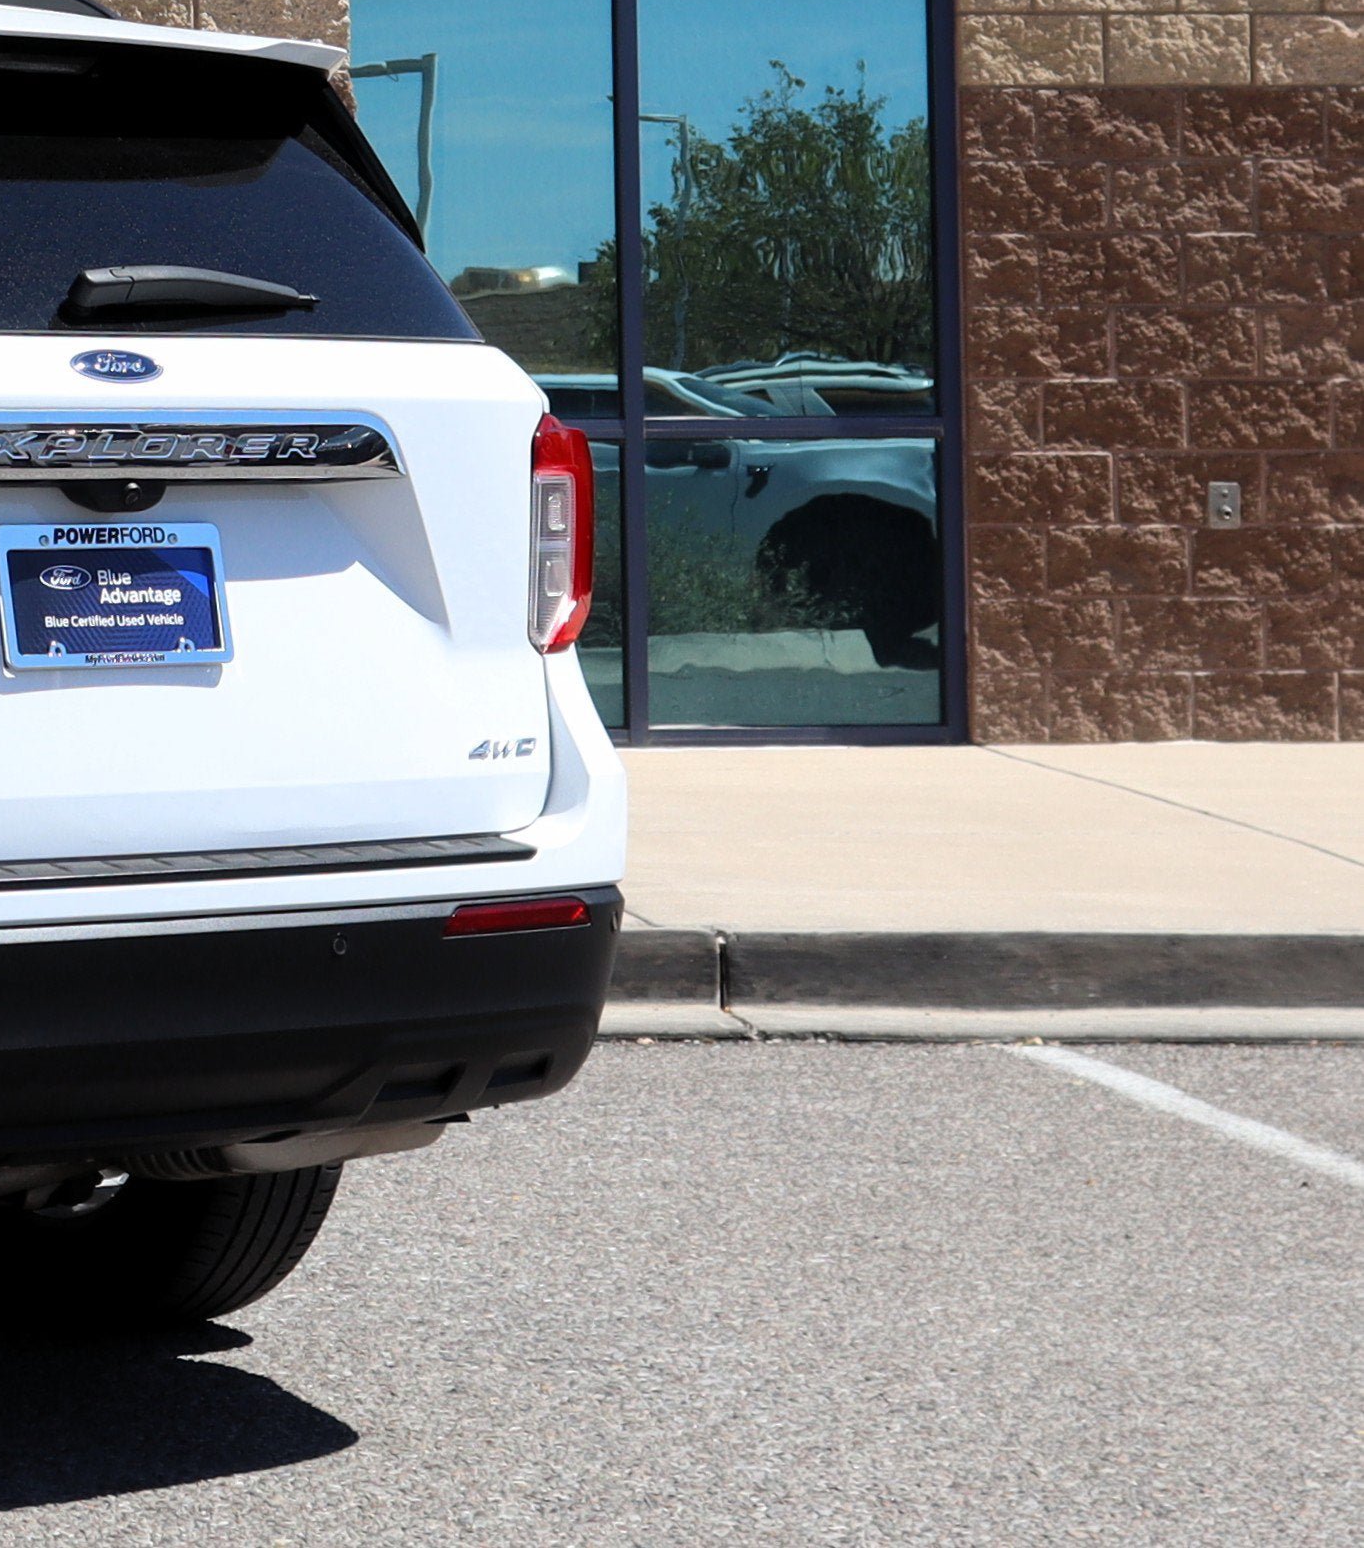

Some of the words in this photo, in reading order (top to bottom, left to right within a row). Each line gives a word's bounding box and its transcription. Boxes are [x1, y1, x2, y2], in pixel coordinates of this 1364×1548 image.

[94, 353, 146, 374] Ford
[50, 568, 81, 586] Ford
[97, 569, 132, 585] Blue
[100, 587, 182, 605] Advantage
[45, 616, 69, 628] Blue
[71, 614, 115, 627] Certified
[116, 615, 144, 627] Used
[146, 613, 185, 626] Vehicle
[468, 738, 536, 760] 4WD
